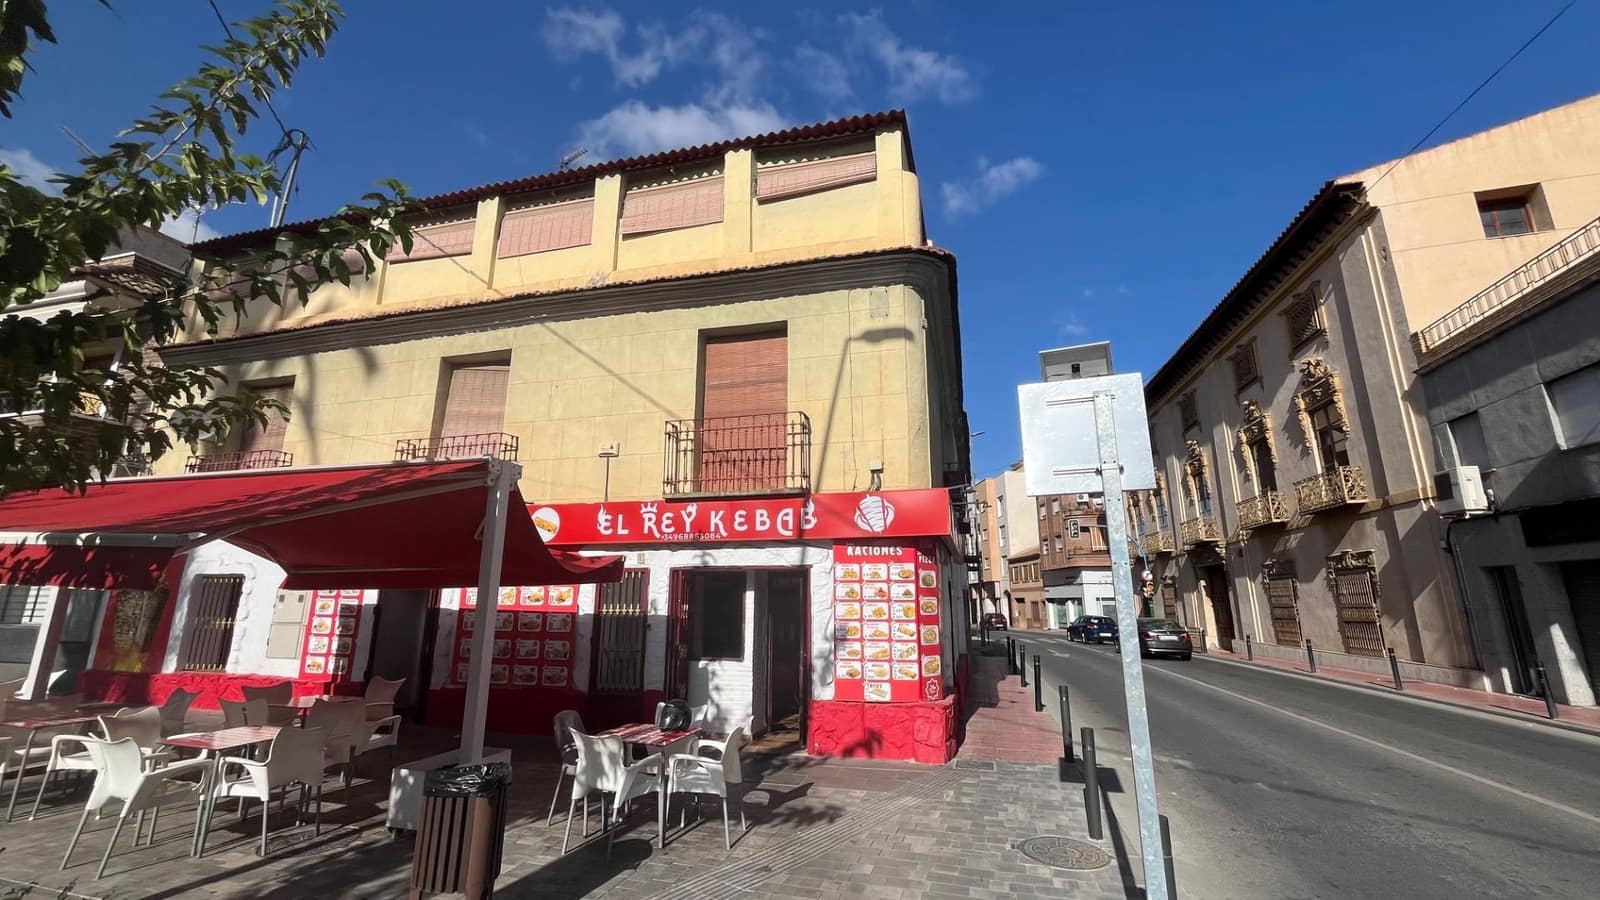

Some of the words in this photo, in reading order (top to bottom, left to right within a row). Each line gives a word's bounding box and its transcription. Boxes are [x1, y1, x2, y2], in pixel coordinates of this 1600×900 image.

[597, 505, 629, 534] EL
[640, 503, 697, 538] REY
[710, 501, 817, 537] KEBAB
[847, 546, 903, 556] RACIONES
